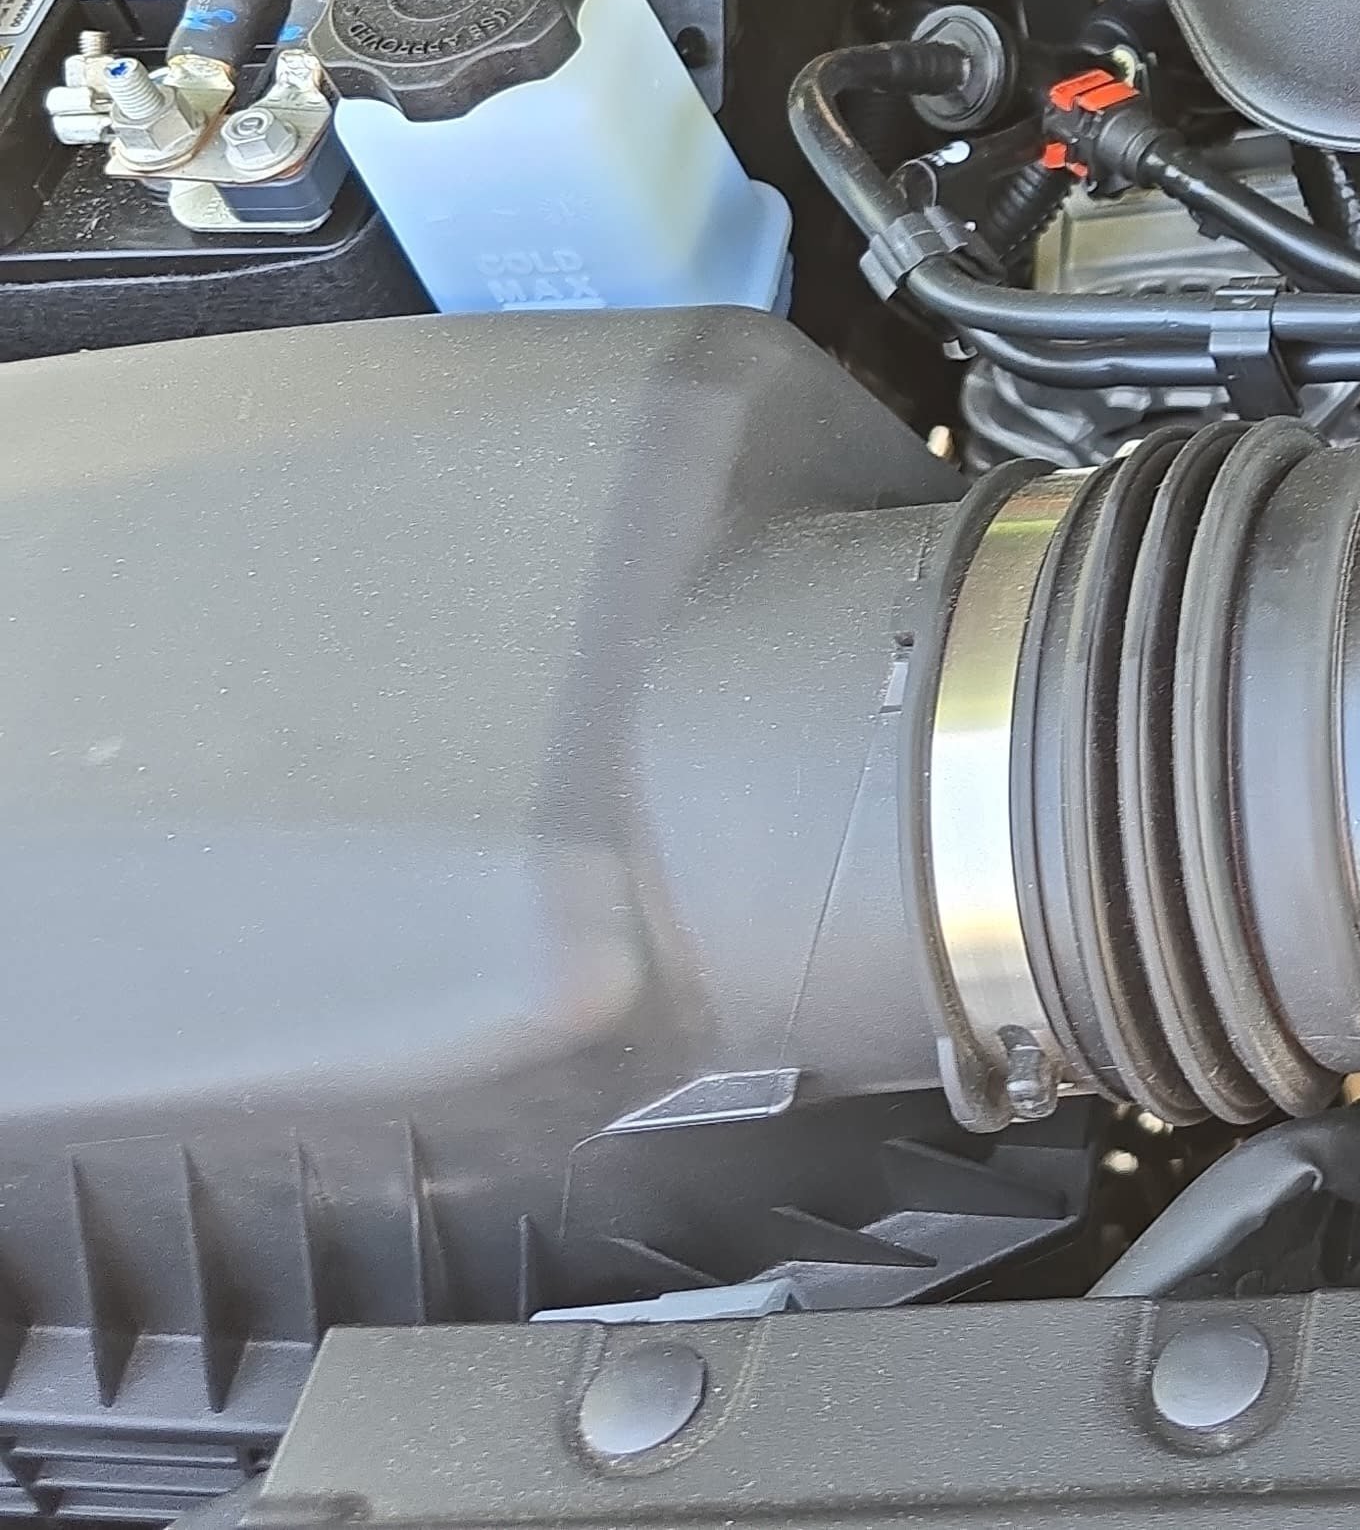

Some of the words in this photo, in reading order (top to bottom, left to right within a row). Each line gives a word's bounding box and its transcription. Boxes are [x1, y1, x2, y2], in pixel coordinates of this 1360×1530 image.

[348, 20, 463, 55] APPROVED
[479, 248, 585, 276] COLD
[487, 276, 600, 303] MAX
